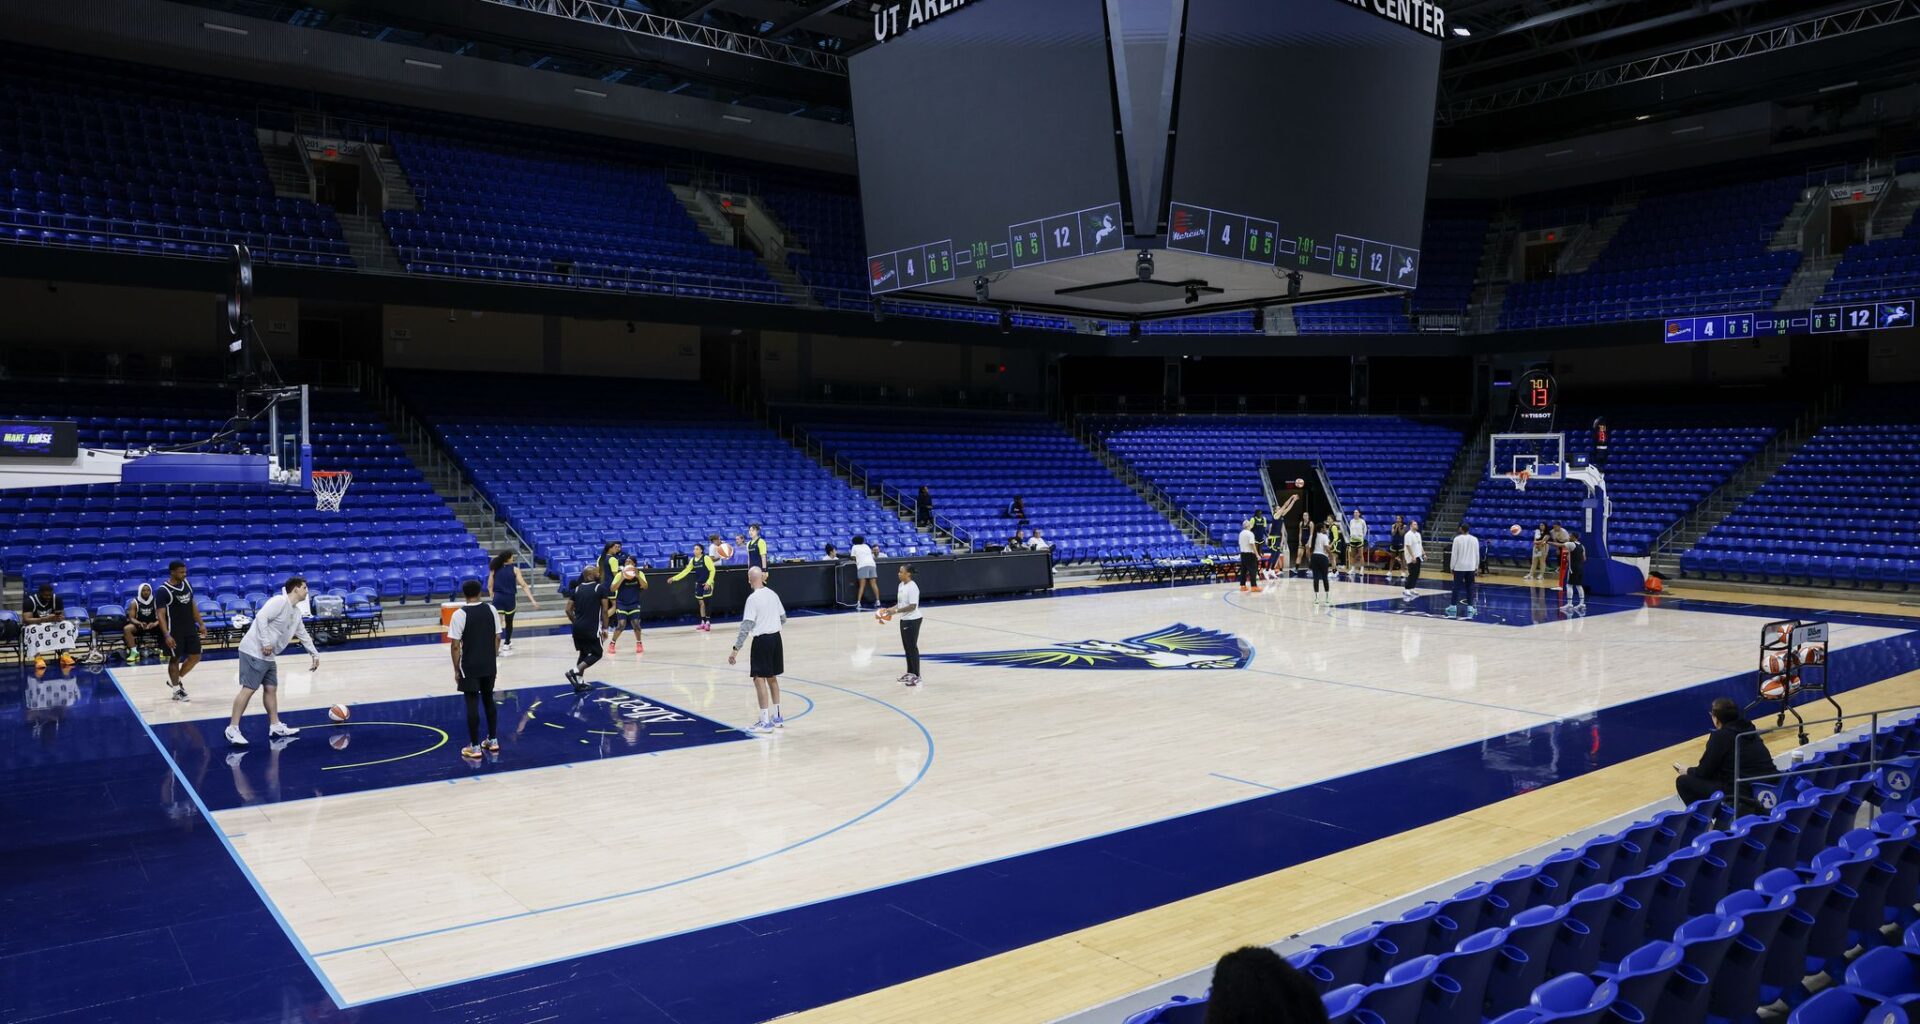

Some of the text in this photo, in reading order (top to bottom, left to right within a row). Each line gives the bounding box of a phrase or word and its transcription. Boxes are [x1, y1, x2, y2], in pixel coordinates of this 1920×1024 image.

[874, 4, 900, 41] UT
[1373, 0, 1445, 38] CENTER
[1054, 226, 1071, 248] 12
[1221, 224, 1231, 246] 4
[971, 241, 989, 258] 7:01
[1015, 241, 1023, 257] 0
[1030, 238, 1039, 255] 5
[1249, 235, 1258, 252] 0
[1263, 237, 1272, 255] 5
[1297, 236, 1314, 254] 7:01
[930, 259, 937, 274] 0
[942, 256, 949, 271] 5
[975, 258, 986, 270] 1ST
[1298, 255, 1310, 265] 1ST
[1337, 251, 1344, 267] 0
[1350, 253, 1357, 269] 5
[1369, 251, 1383, 272] 12
[907, 258, 915, 277] 4
[1773, 319, 1790, 329] 7:01
[1815, 318, 1822, 329] 0
[1829, 317, 1836, 328] 5
[1848, 309, 1870, 327] 12
[1704, 321, 1714, 337] 4
[1729, 324, 1736, 335] 0
[1742, 323, 1749, 334] 5
[1529, 378, 1549, 389] 7:01
[1533, 388, 1547, 406] 13
[4, 433, 52, 444] MAKE NOISE
[592, 695, 697, 723] Albert
